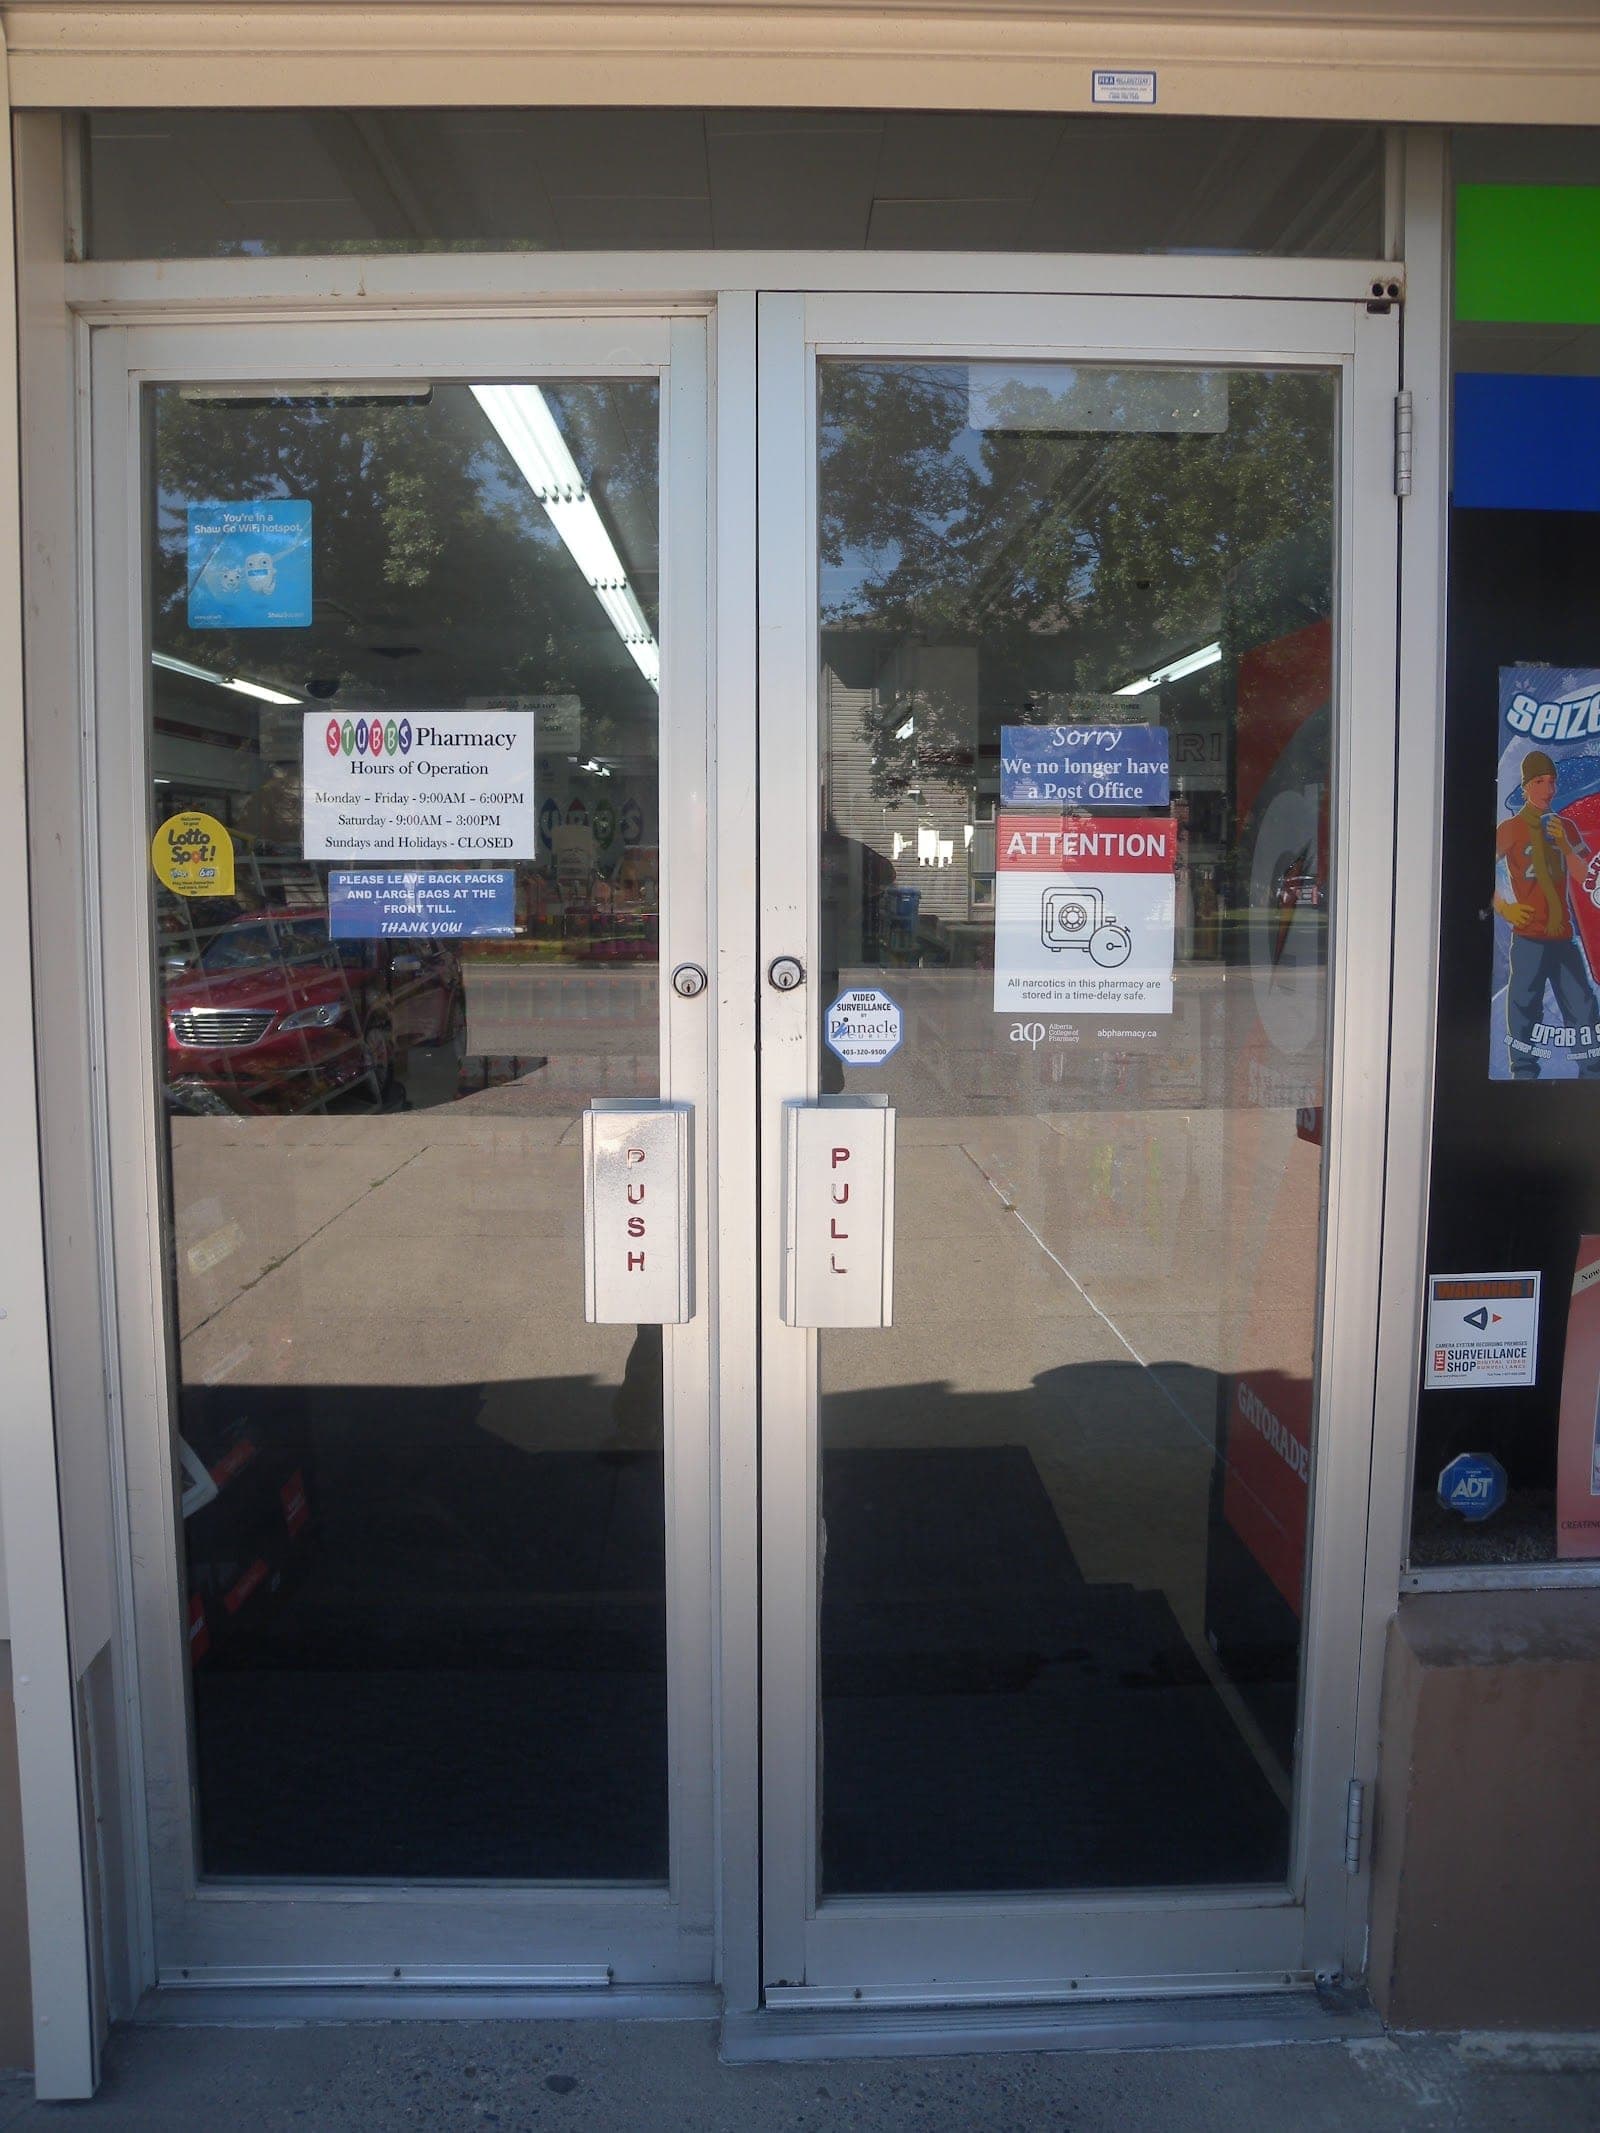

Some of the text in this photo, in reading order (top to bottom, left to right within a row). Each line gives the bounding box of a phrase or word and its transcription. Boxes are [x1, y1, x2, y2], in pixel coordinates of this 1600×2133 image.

[223, 513, 255, 522] You're
[256, 513, 265, 521] in
[195, 525, 221, 534] Shaw
[223, 525, 236, 533] Go
[240, 523, 260, 533] WiFi
[327, 722, 517, 753] STUBBS Pharmacy
[1052, 726, 1122, 751] Sorry
[351, 761, 488, 777] Hours of Operation
[1002, 758, 1169, 779] We no longer have
[1028, 783, 1143, 799] a Post Office
[315, 793, 361, 805] Monday
[375, 793, 409, 806] Friday
[419, 793, 465, 803] 9:00AM
[479, 793, 524, 804] 6:00PM
[338, 815, 386, 827] Saturday
[396, 815, 442, 826] 9:00AM
[456, 815, 501, 826] 3:00PM
[168, 828, 210, 845] Lotto
[325, 837, 371, 849] Sundays
[374, 837, 394, 848] and
[398, 837, 447, 849] Holidays
[457, 837, 513, 848] CLOSED
[1007, 832, 1165, 857] ATTENTION
[339, 874, 504, 884] PLEASE LEAVE BACK PACKS
[347, 889, 496, 899] AND LARGE BAGS AT THE
[384, 904, 456, 914] FRONT TILL.
[380, 922, 463, 934] THANK YOU!
[1007, 978, 1020, 987] All
[1022, 979, 1066, 988] narcotics
[1068, 979, 1076, 987] in
[1079, 979, 1096, 988] this
[1099, 979, 1144, 990] pharmacy
[852, 993, 876, 1001] VIDEO
[1022, 991, 1051, 999] stored
[1054, 991, 1062, 999] in
[1073, 991, 1122, 1001] time-delay
[1124, 991, 1146, 1000] safe.
[837, 1003, 891, 1011] SURVEILLANCE
[831, 1018, 897, 1033] Pinnacle
[1097, 1029, 1157, 1039] abpharmacy.ca
[1580, 1026, 1592, 1045] a
[627, 1149, 645, 1271] PUSH
[830, 1148, 850, 1273] PULL
[1447, 1348, 1527, 1360] SURVEILLANCE
[1435, 1350, 1445, 1371] THE
[1447, 1361, 1476, 1372] SHOP
[1238, 1381, 1310, 1484] GATORADE
[1451, 1477, 1494, 1498] ADT
